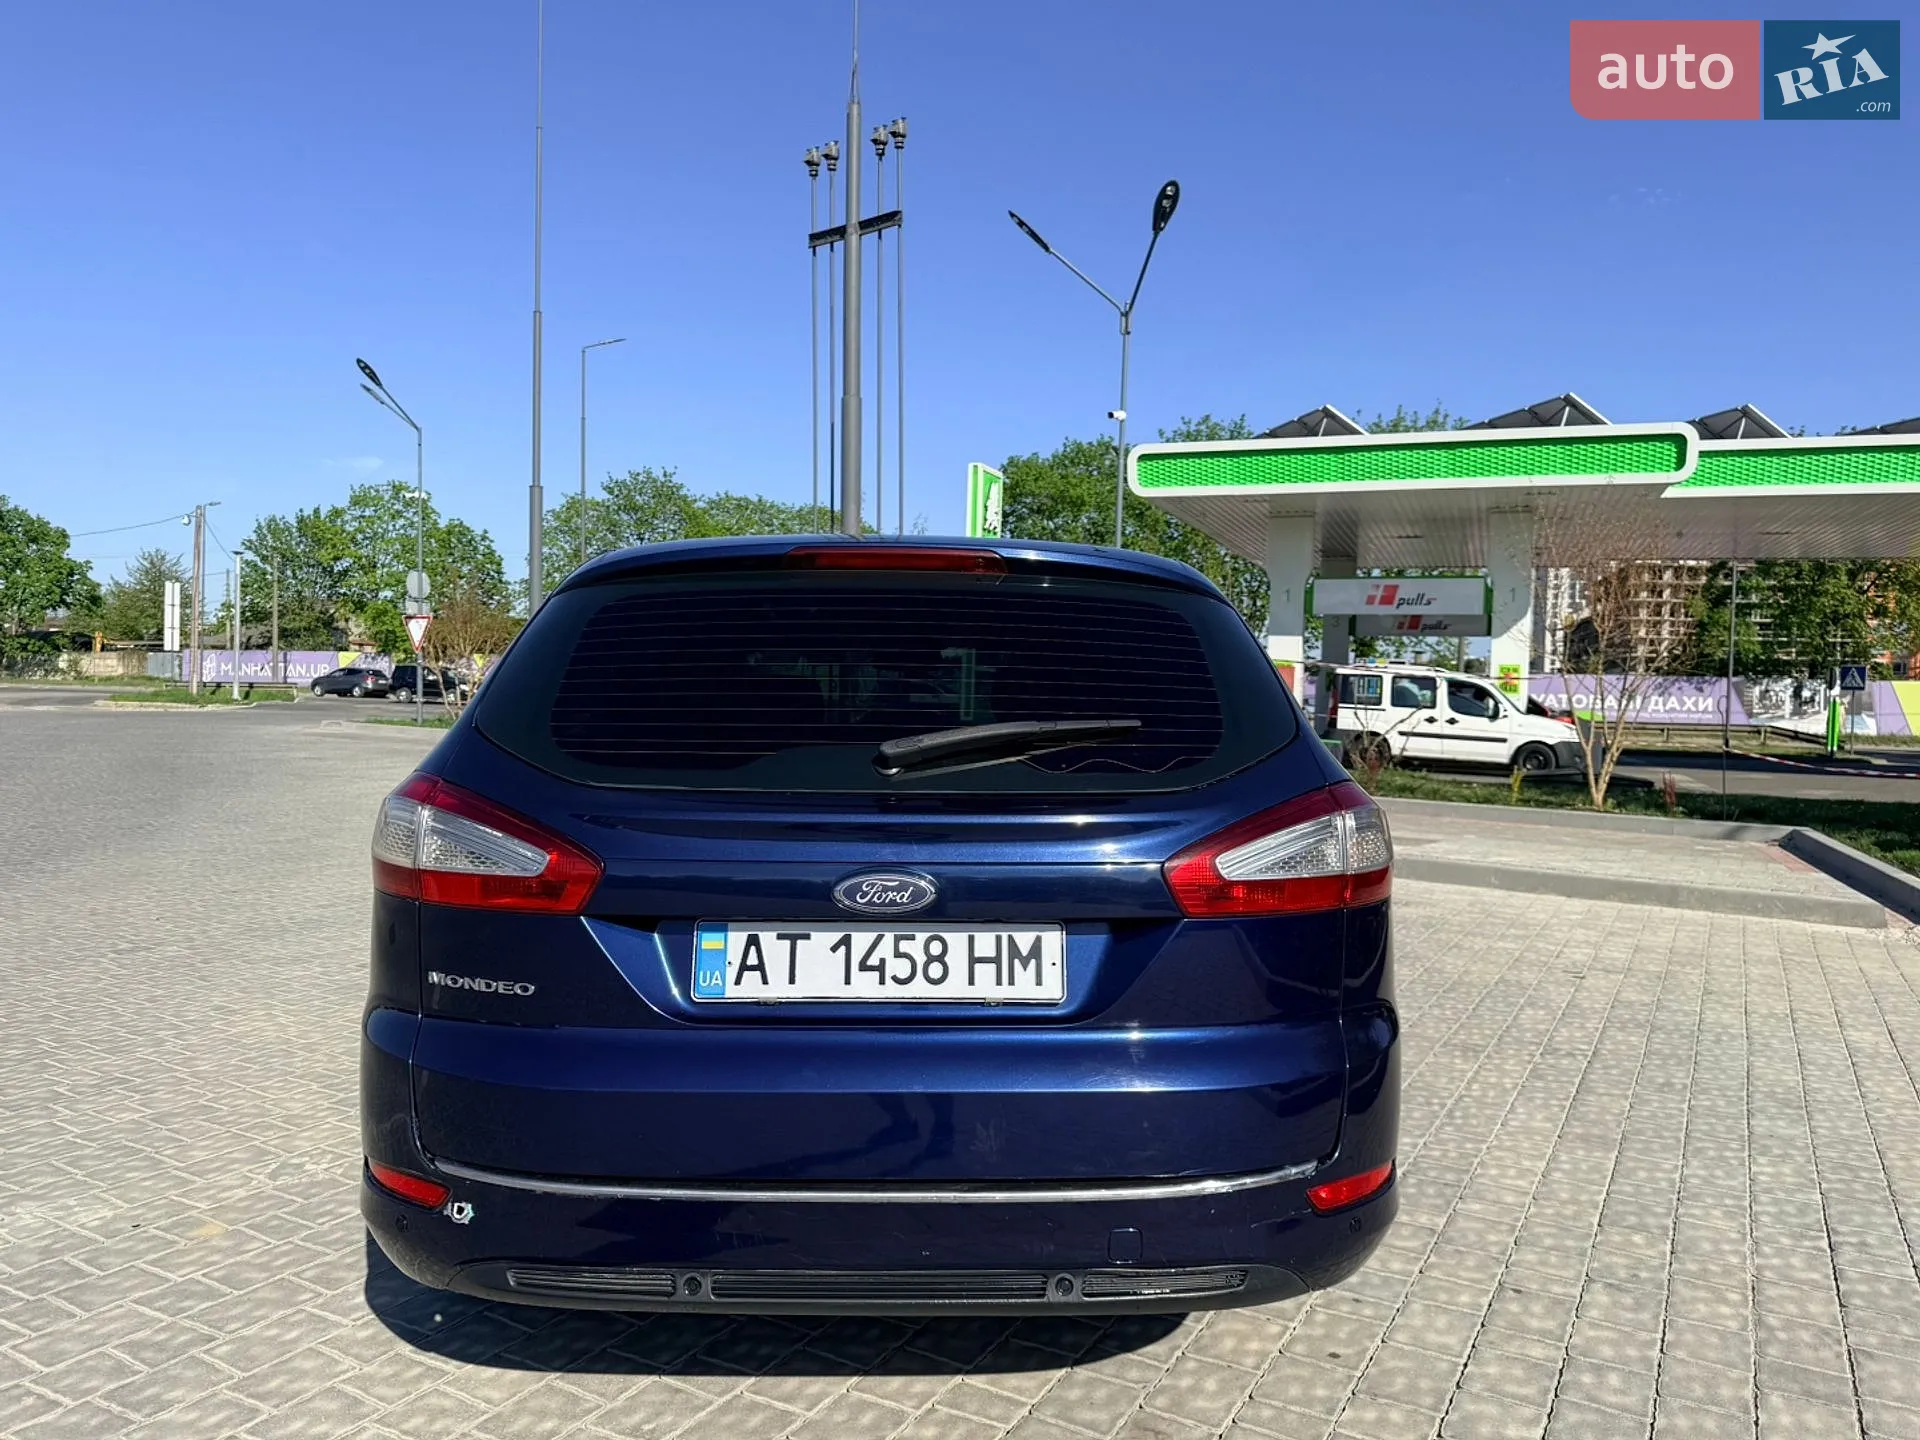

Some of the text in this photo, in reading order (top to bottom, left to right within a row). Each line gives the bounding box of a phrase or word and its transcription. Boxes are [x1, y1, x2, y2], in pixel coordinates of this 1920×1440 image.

[1396, 593, 1437, 609] pulls
[220, 662, 330, 678] MNHATAN.UP
[1648, 695, 1713, 713] ДАХИ
[856, 880, 914, 904] Ford
[733, 932, 1043, 987] AT 1458 HM
[427, 971, 535, 996] MONDEO
[700, 970, 723, 987] UA
